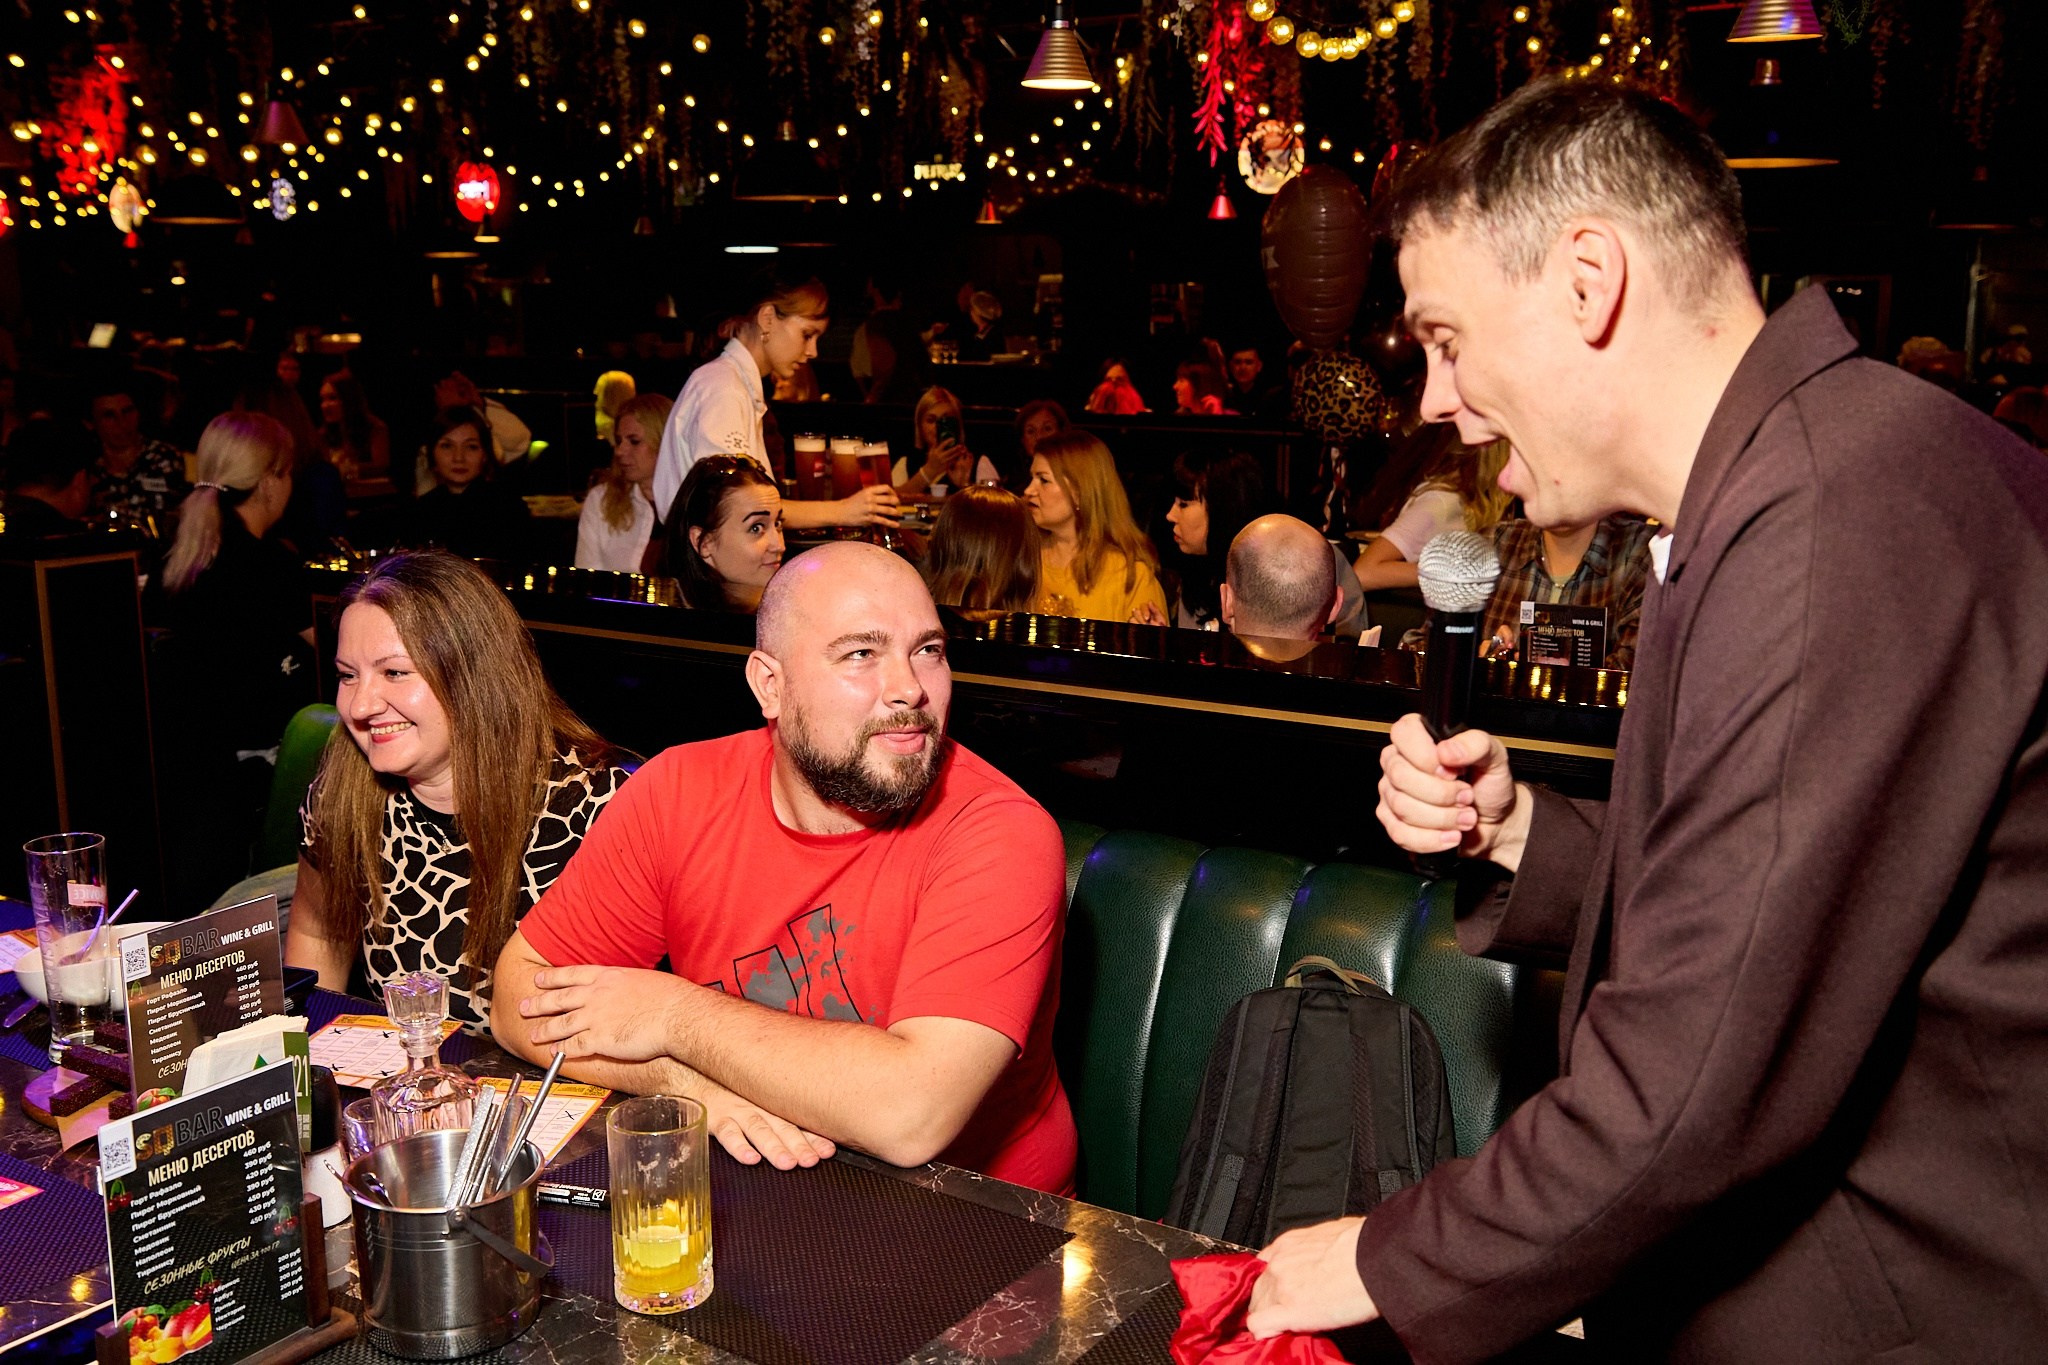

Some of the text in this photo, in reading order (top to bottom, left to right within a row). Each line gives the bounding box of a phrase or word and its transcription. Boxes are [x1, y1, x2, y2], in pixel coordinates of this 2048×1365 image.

[220, 931, 244, 946] WINE
[244, 927, 251, 937] &
[251, 920, 274, 935] GRILL
[160, 950, 245, 990] МЕНЮ ДЕСЕРТОВ
[248, 961, 258, 970] руб
[248, 970, 259, 979] руб
[249, 980, 259, 989] руб
[250, 989, 260, 998] руб
[147, 992, 202, 1015] Пирог Морковный
[251, 998, 261, 1007] руб
[148, 1001, 205, 1025] Пирог Брусничный
[252, 1008, 262, 1017] руб
[149, 1020, 182, 1034] Сметанник
[150, 1032, 177, 1045] Медовик
[151, 1040, 181, 1054] Наполеон
[152, 1050, 181, 1064] Тирамису
[158, 1058, 187, 1078] СЕЗОН
[225, 1108, 253, 1126] WINE
[254, 1102, 262, 1114] &
[263, 1091, 291, 1112] GRILL
[243, 1141, 271, 1157] 460 руб
[148, 1130, 256, 1187] МЕНЮ ДЕСЕРТОВ
[245, 1152, 272, 1169] 390 руб
[246, 1164, 272, 1180] 420 руб
[247, 1175, 274, 1192] 390 руб
[248, 1186, 275, 1202] 450 руб
[131, 1185, 201, 1220] Пирог Морковный
[249, 1197, 276, 1213] 430 руб
[132, 1195, 205, 1231] Пирог Брусничный
[250, 1208, 277, 1224] 450 руб
[133, 1221, 176, 1243] Сметанник
[134, 1236, 169, 1255] Медовик
[290, 1248, 301, 1258] руб
[136, 1246, 174, 1267] Наполеон
[291, 1257, 301, 1267] руб
[136, 1258, 175, 1278] Тирамису
[144, 1236, 251, 1294] СЕЗОННЫЕ ФРУКТЫ
[291, 1266, 302, 1276] руб
[292, 1275, 303, 1285] руб
[293, 1284, 303, 1295] руб
